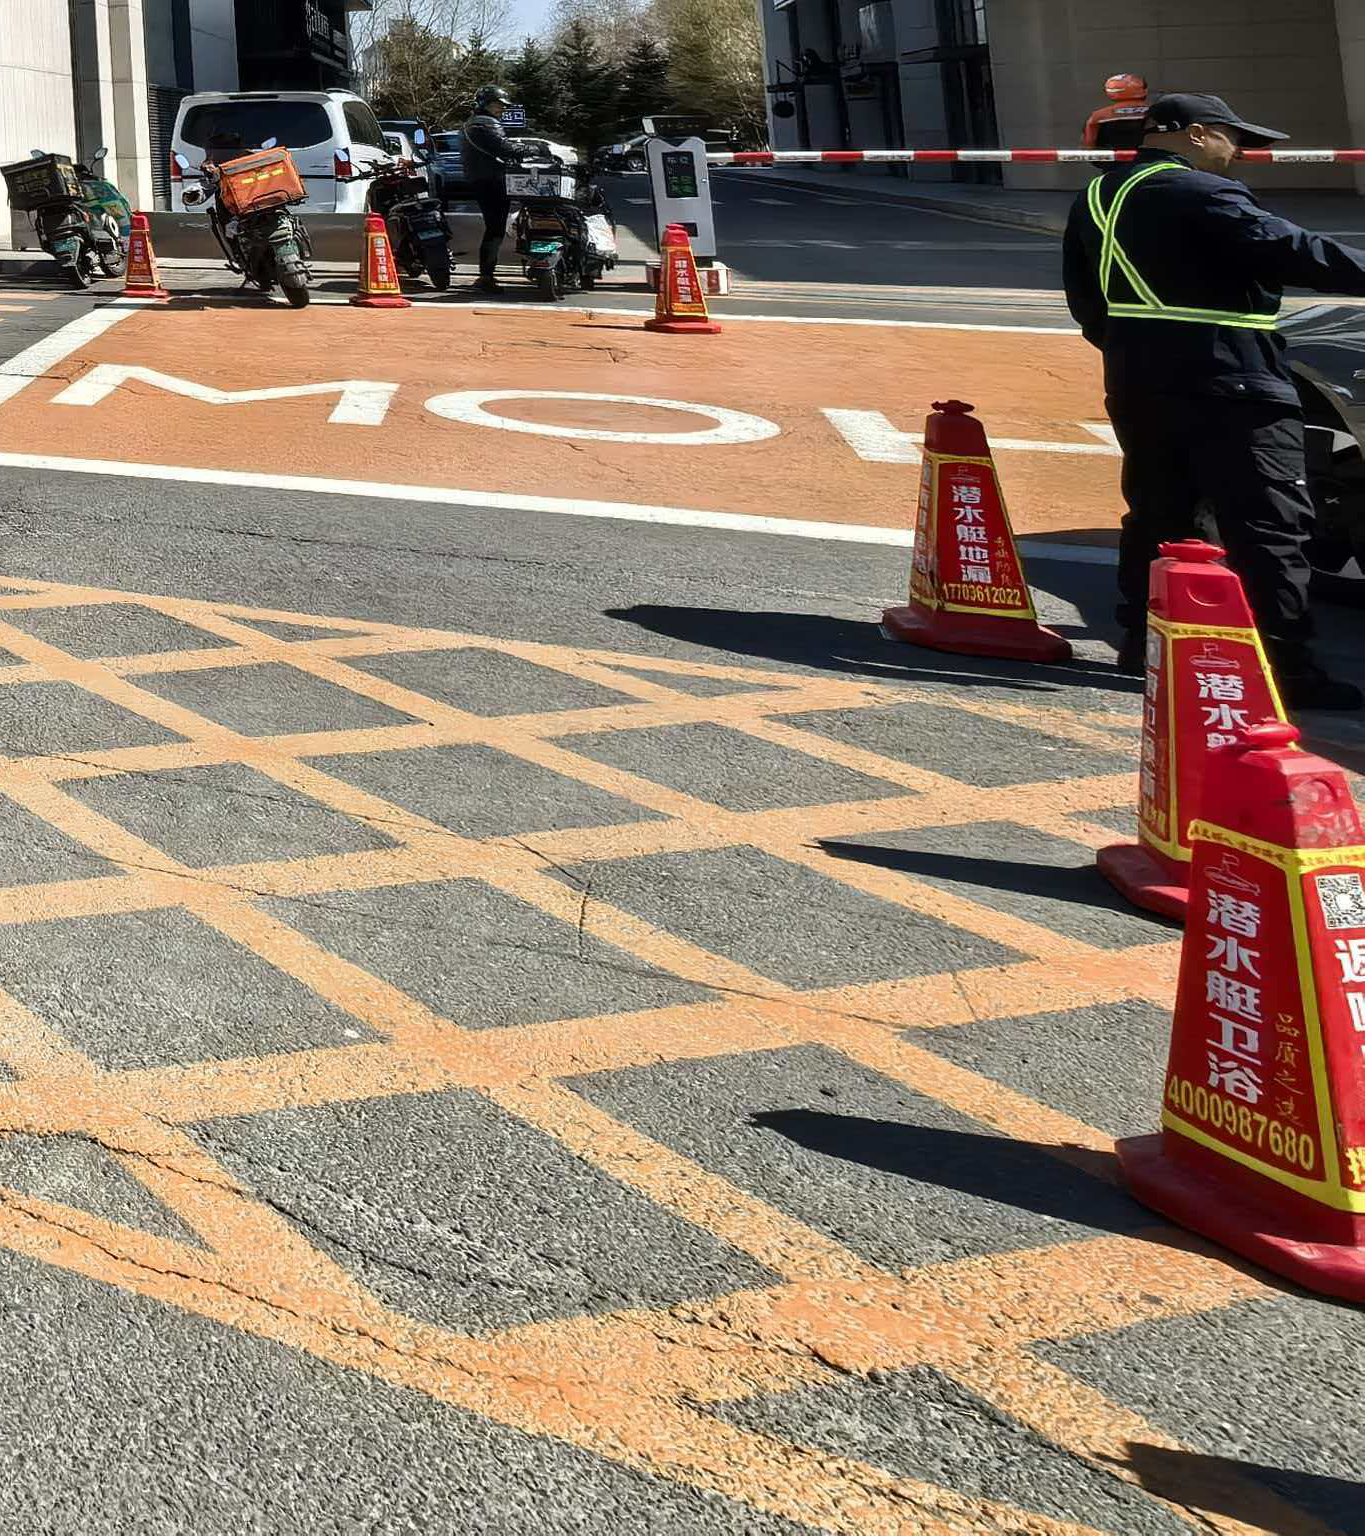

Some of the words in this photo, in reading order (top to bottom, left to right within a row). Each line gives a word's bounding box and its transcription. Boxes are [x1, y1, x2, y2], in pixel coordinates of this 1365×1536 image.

[951, 484, 992, 585] 潜水艇地漏
[942, 582, 1022, 607] 17703612022
[1205, 888, 1264, 1104] 潜水艇卫浴
[1168, 1074, 1315, 1172] 4000987680
